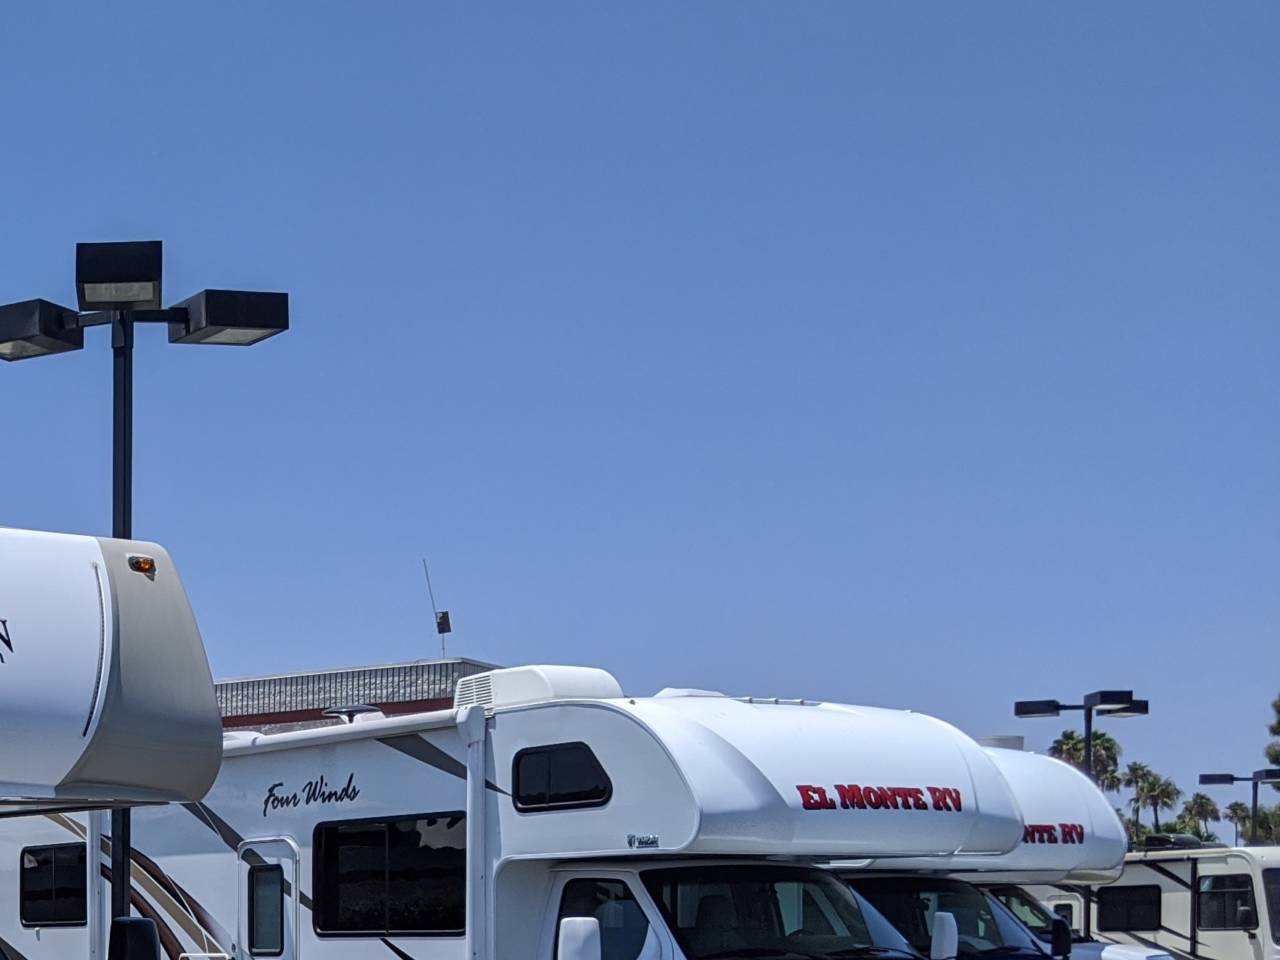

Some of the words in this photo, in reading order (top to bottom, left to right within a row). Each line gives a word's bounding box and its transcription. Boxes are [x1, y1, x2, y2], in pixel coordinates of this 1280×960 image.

[263, 782, 301, 817] Four
[302, 773, 360, 805] Winds
[796, 785, 837, 810] EL
[833, 784, 929, 810] MONTE
[926, 786, 962, 812] RV
[1021, 824, 1058, 844] NTE
[1058, 823, 1084, 844] RV
